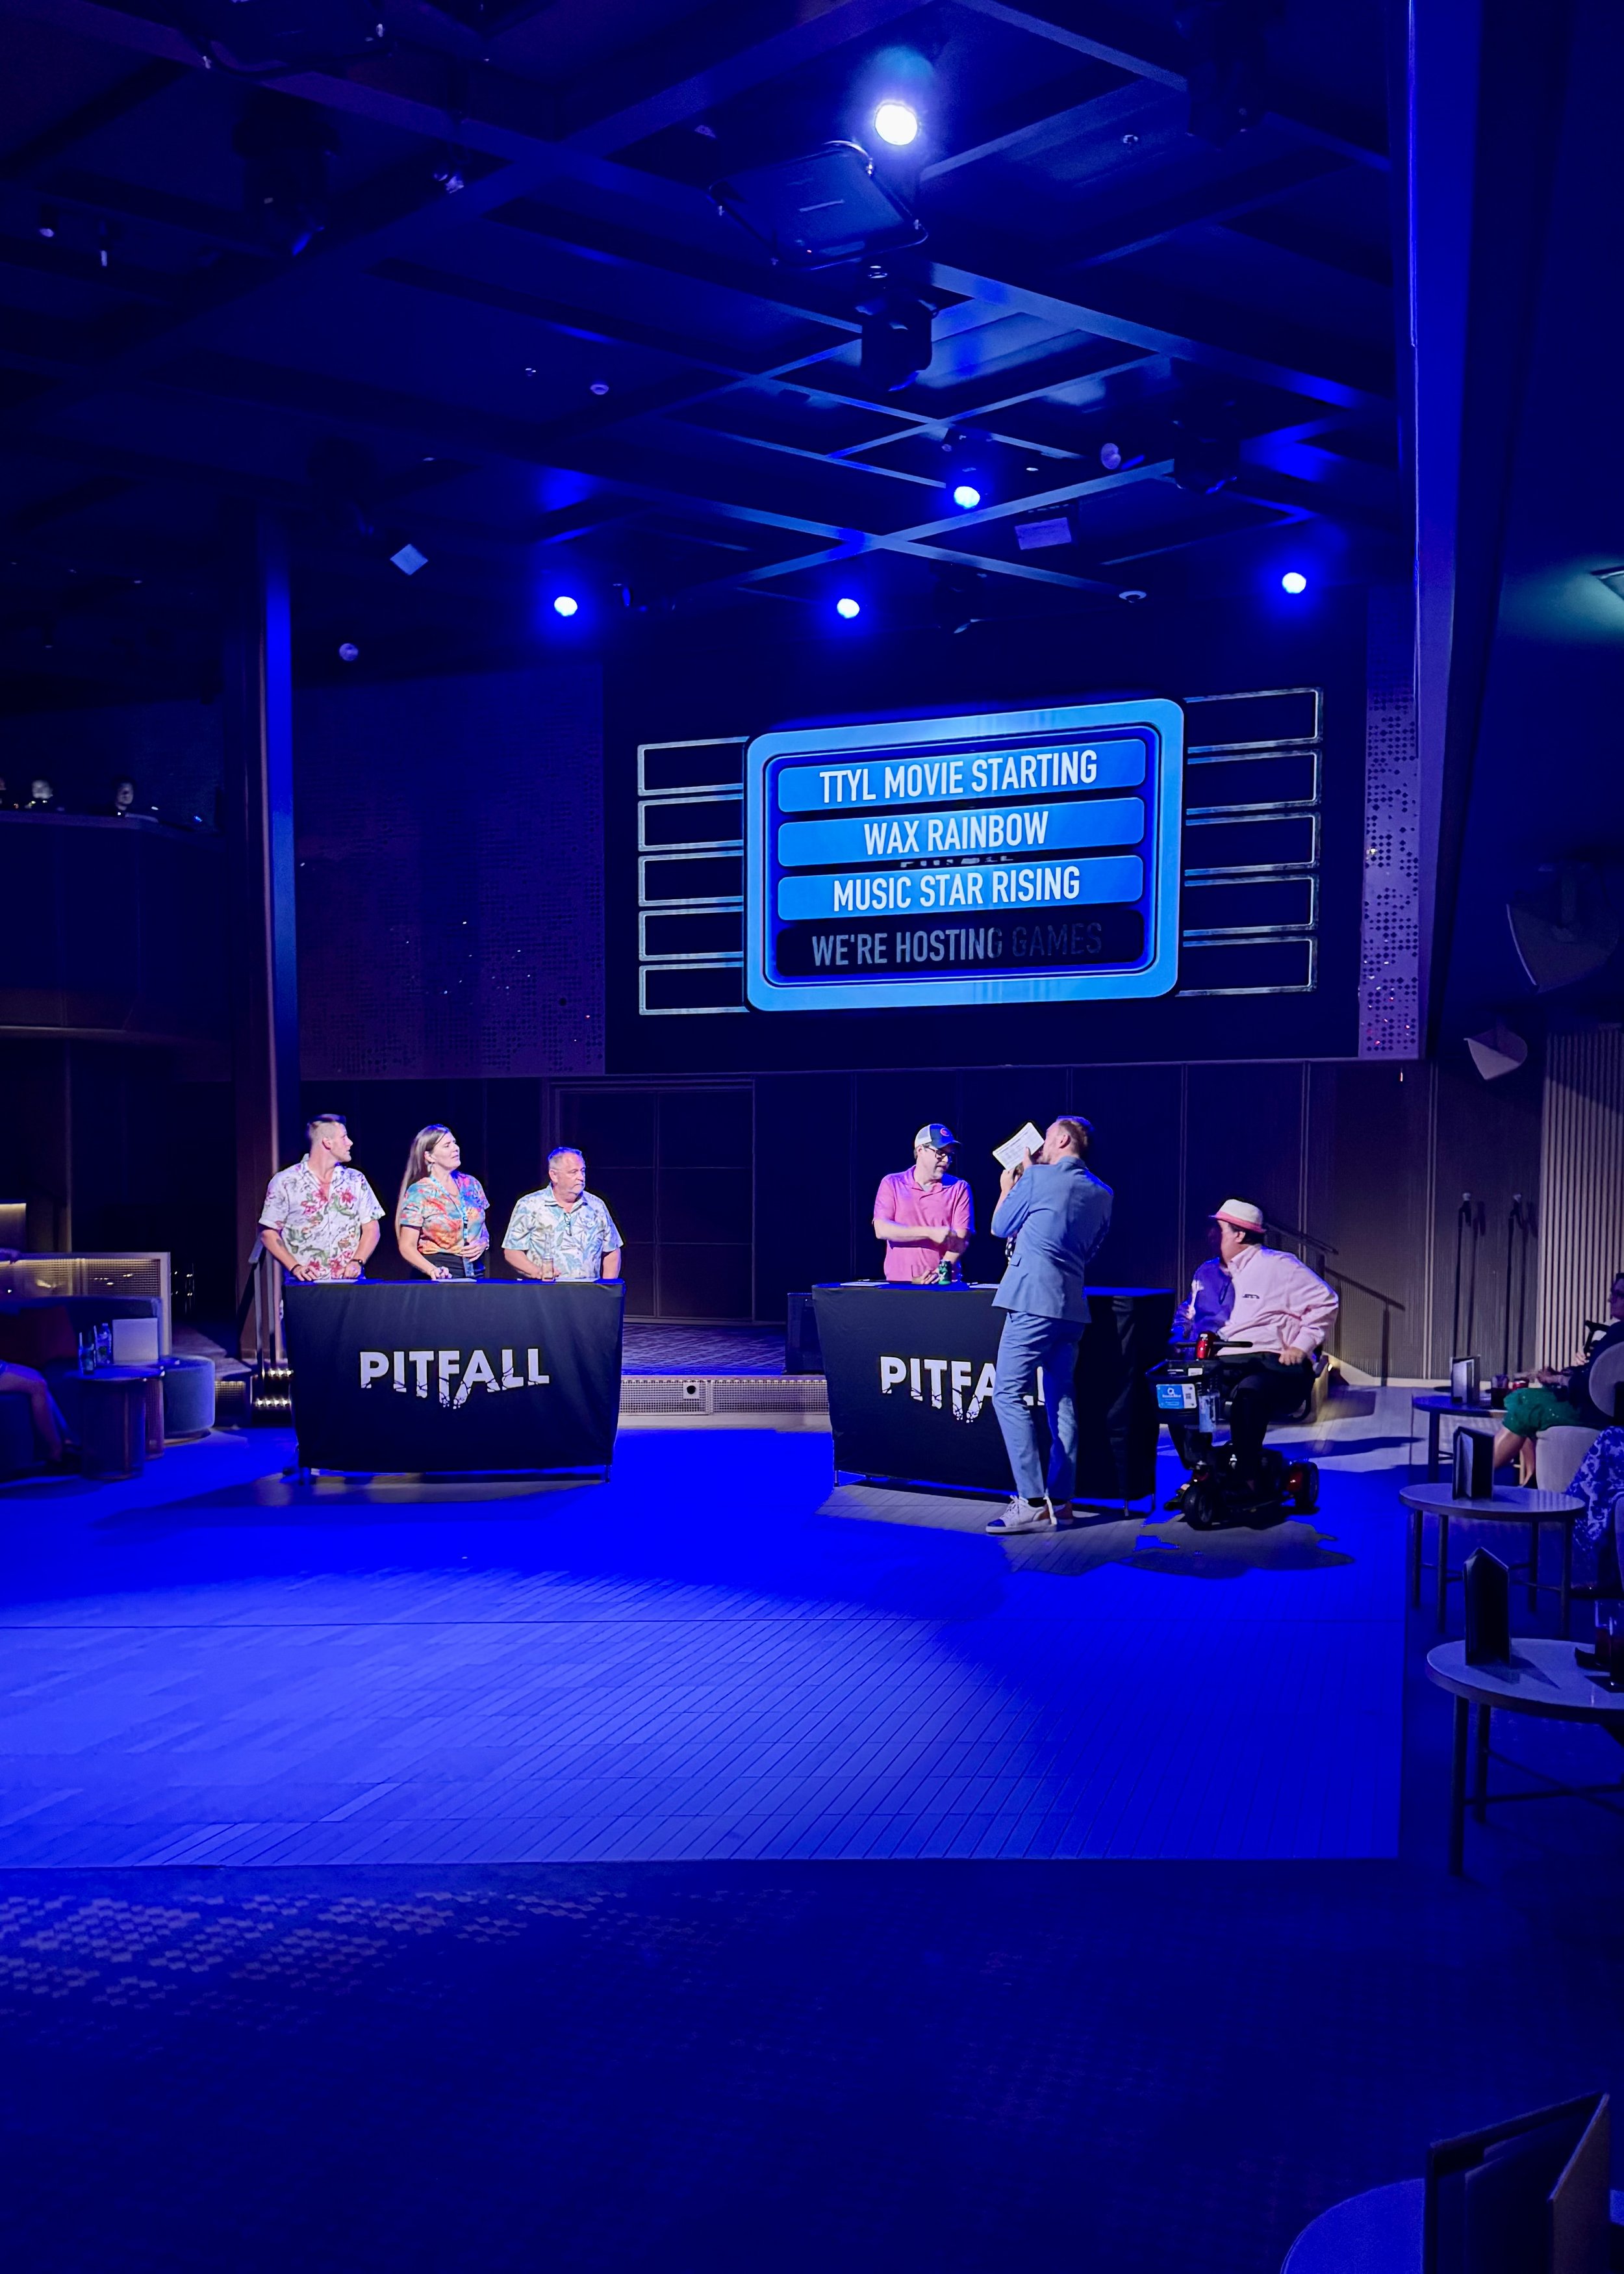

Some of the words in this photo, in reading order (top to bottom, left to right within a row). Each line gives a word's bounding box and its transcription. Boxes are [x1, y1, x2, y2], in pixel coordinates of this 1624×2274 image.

[819, 768, 876, 803] TTYL
[884, 761, 964, 799] MOVIE
[971, 750, 1097, 792] STARTING
[863, 820, 920, 855] WAX
[928, 811, 1049, 851] RAINBOW
[833, 876, 911, 911] MUSIC
[920, 873, 983, 907] STAR
[992, 865, 1080, 904] RISING
[812, 932, 888, 966] WE'RE
[895, 927, 1003, 963] HOSTING
[1011, 922, 1102, 957] GAMES
[359, 1348, 550, 1409] PITFALL
[880, 1355, 1045, 1423] PITFA
